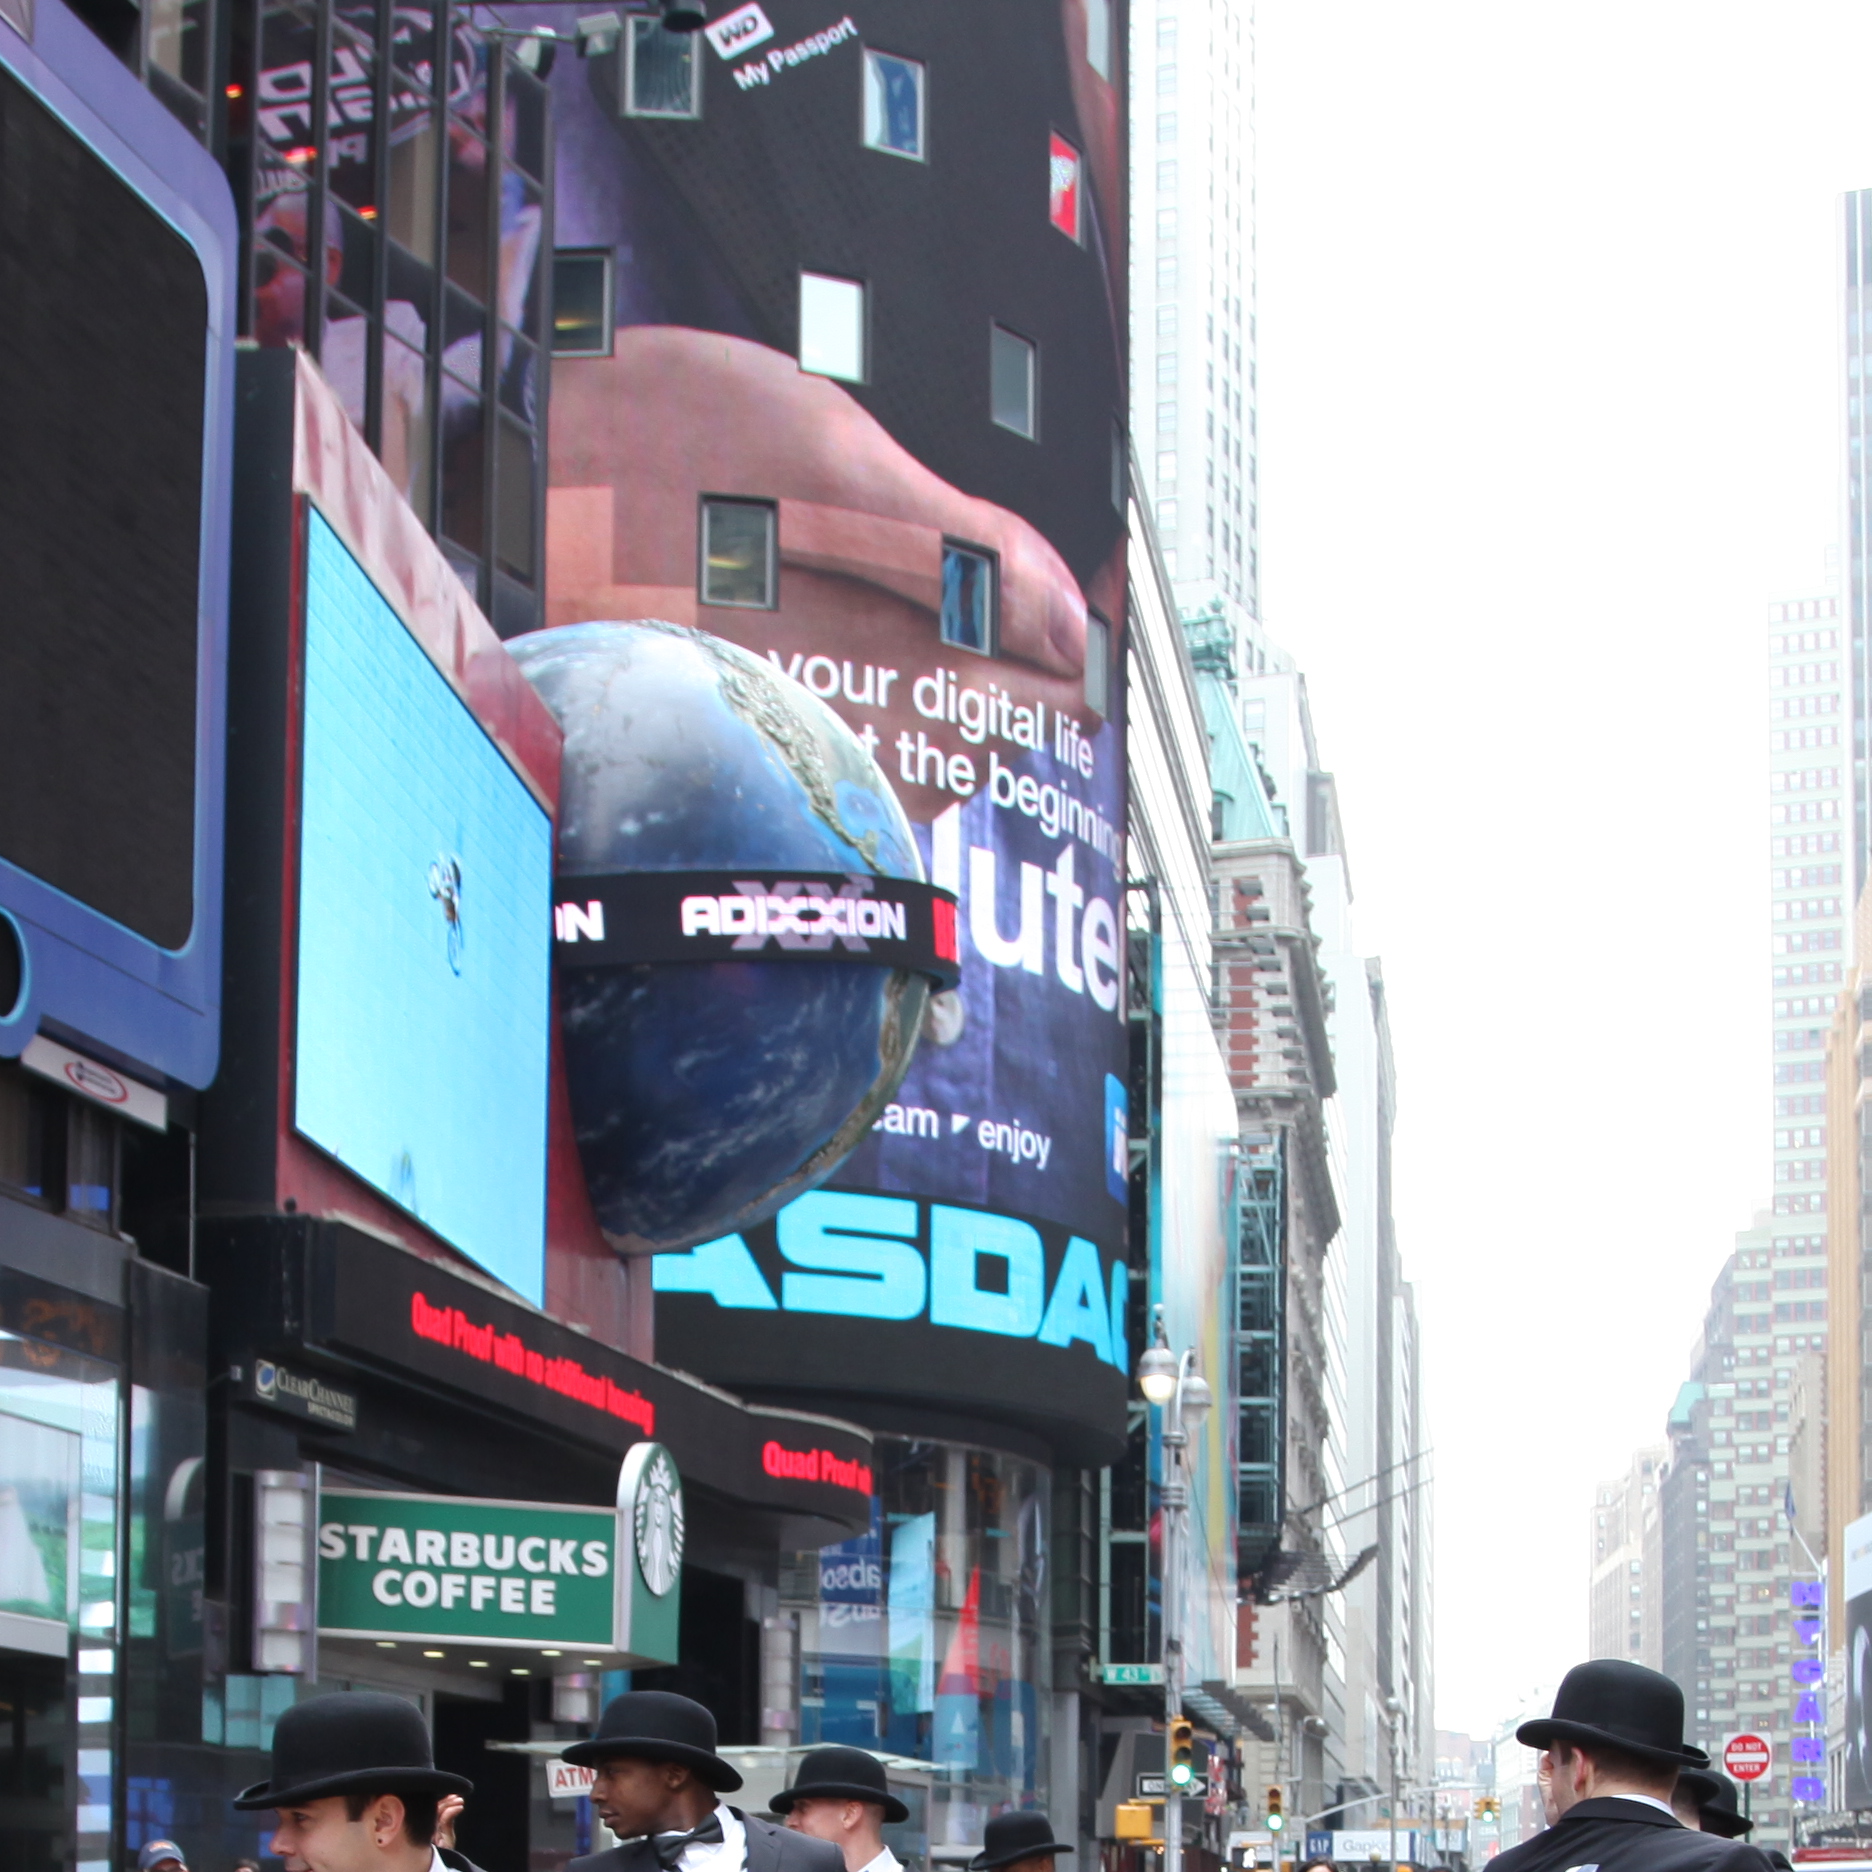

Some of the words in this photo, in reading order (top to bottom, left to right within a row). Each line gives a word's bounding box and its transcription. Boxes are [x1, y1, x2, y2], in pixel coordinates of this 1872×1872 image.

[733, 60, 770, 91] My
[766, 15, 859, 73] Passport
[767, 649, 899, 708] your
[912, 667, 1045, 753] digital
[1054, 710, 1095, 779] life
[895, 731, 976, 797] the
[977, 1120, 1052, 1170] enjoy
[762, 1440, 820, 1482] Quad
[319, 1522, 609, 1578] STARBUCKS
[372, 1569, 557, 1617] COFFEE
[1731, 1742, 1744, 1752] DO
[1745, 1742, 1762, 1752] NOT
[1733, 1763, 1761, 1773] ENTER
[555, 1767, 595, 1788] ATM
[1309, 1838, 1330, 1854] GAP
